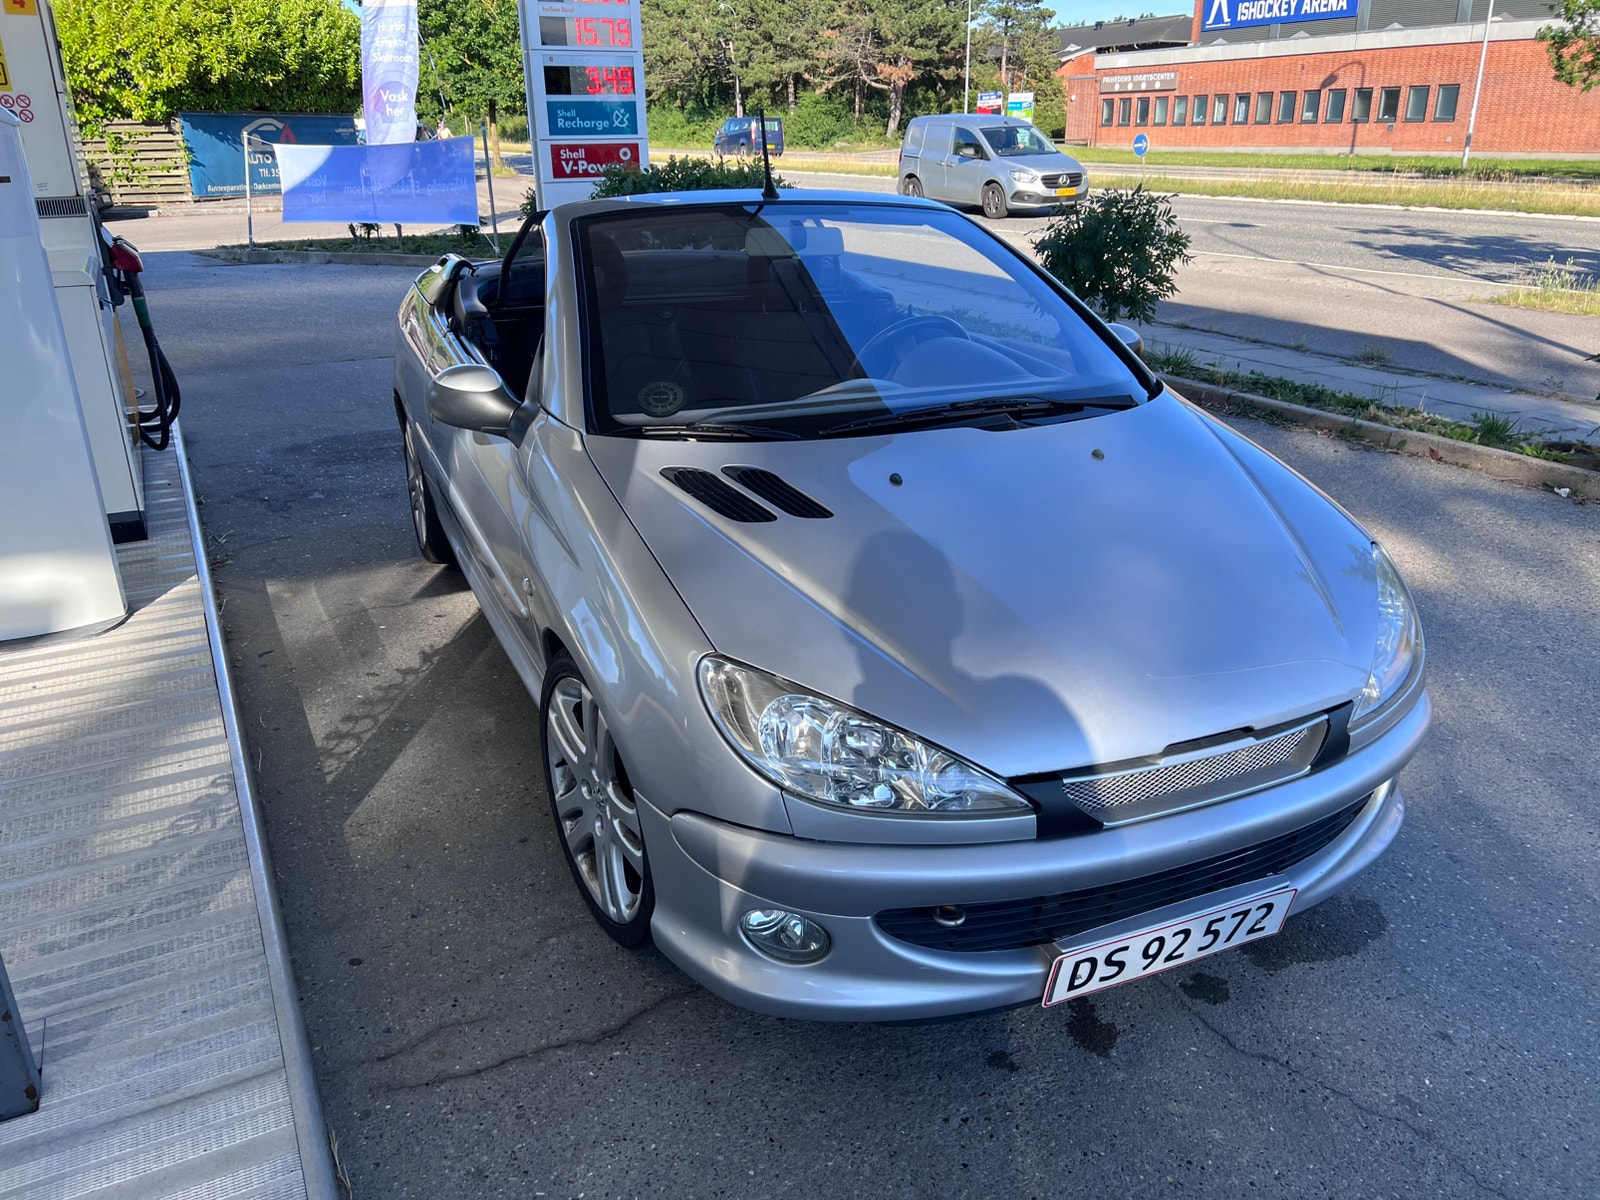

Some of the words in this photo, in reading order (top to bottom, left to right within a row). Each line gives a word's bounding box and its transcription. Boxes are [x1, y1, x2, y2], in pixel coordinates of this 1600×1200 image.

[1237, 1, 1296, 21] ISHOCKEY
[1301, 0, 1347, 14] ARENA
[377, 22, 406, 33] Hurtig
[574, 17, 630, 46] 15.79
[585, 66, 634, 95] 3.49
[380, 90, 409, 102] Vask
[386, 104, 405, 116] her
[557, 109, 576, 117] Shell
[557, 118, 610, 131] Recharge
[560, 148, 585, 159] Shell
[1067, 946, 1130, 993] DS
[1142, 928, 1192, 971] 92
[1197, 902, 1275, 952] 572
